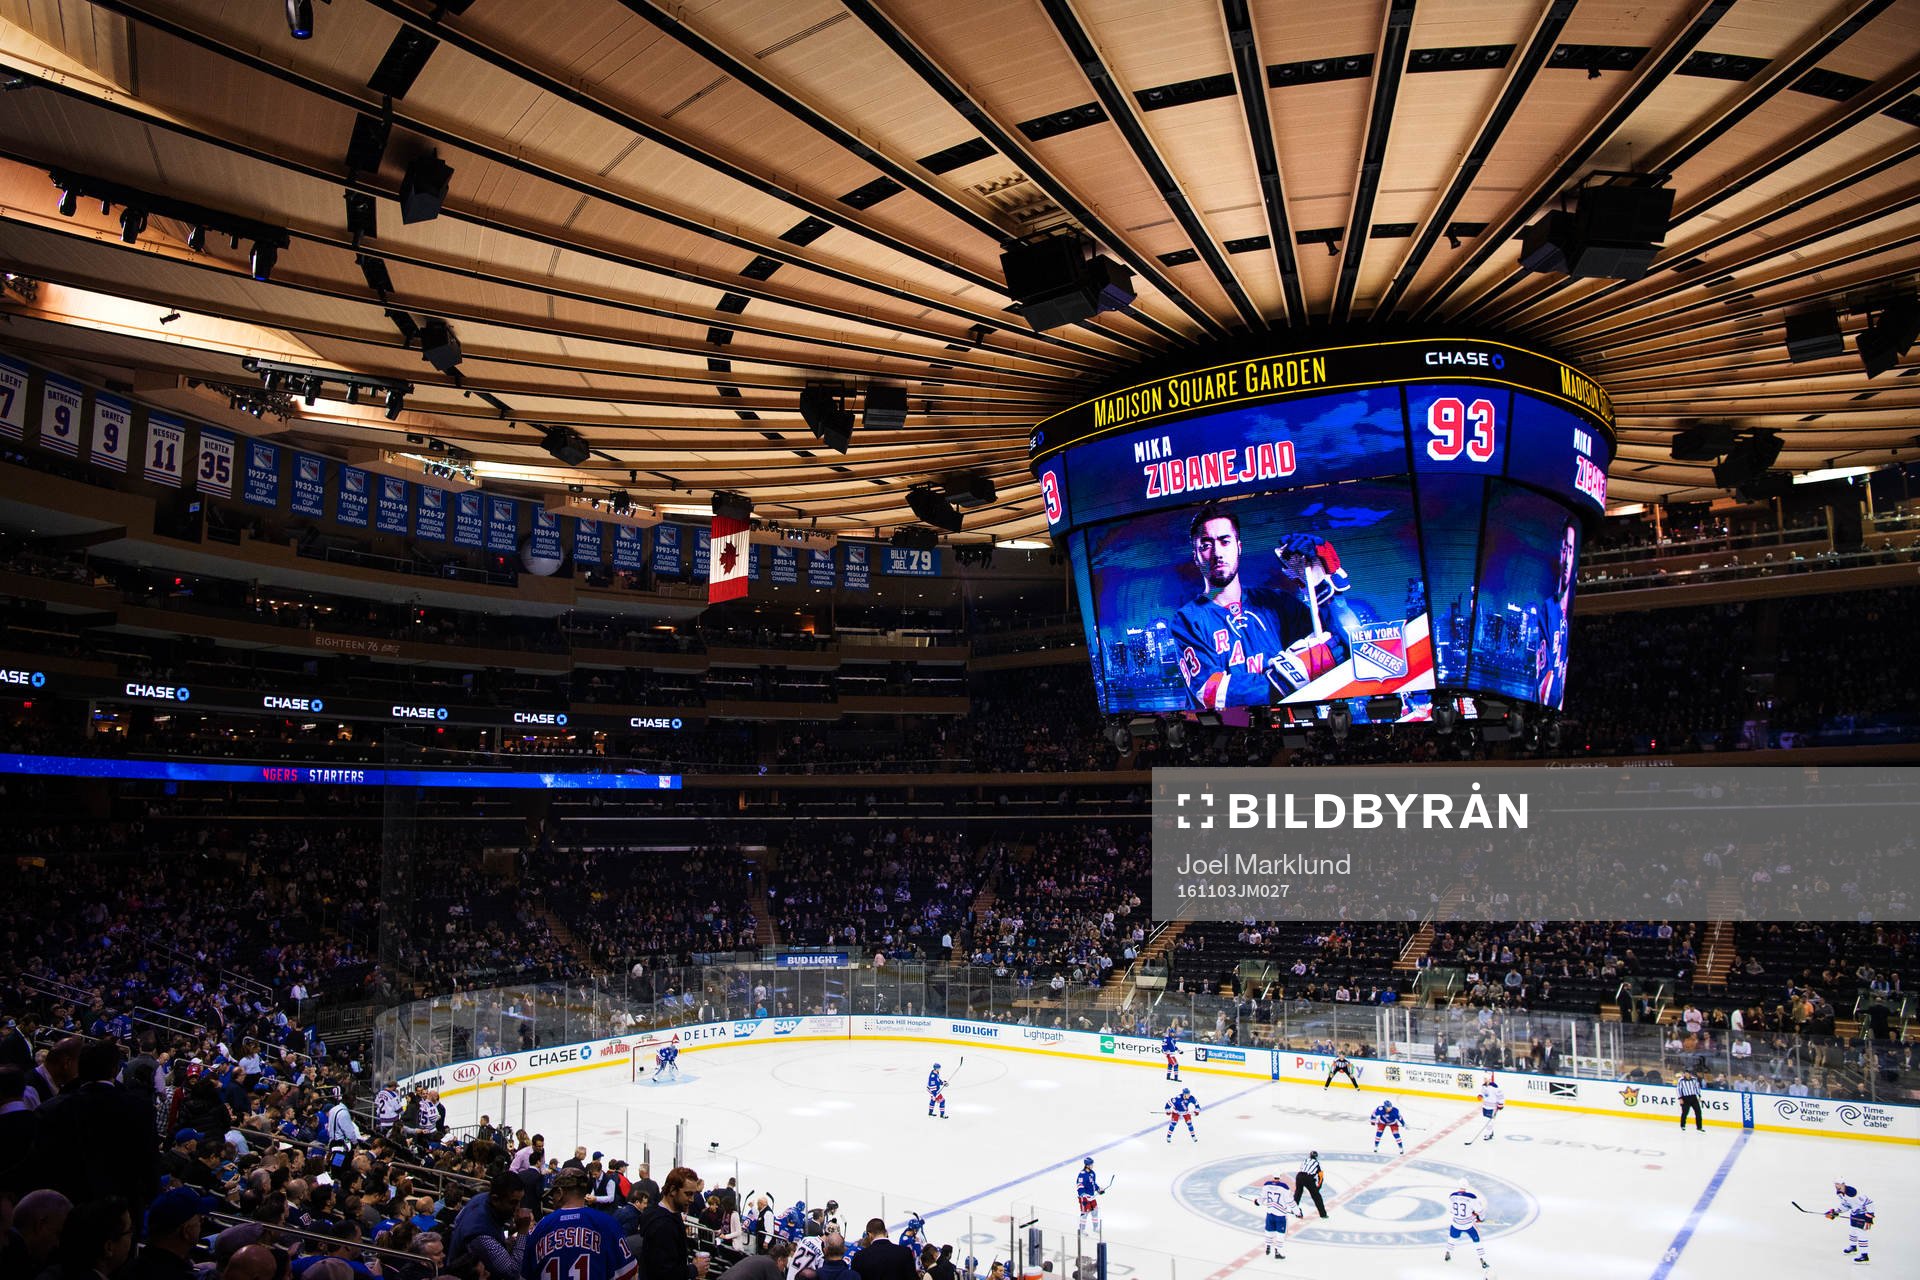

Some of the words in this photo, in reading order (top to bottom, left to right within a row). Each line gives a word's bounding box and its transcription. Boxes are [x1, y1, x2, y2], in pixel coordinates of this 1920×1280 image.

[1425, 351, 1489, 366] CHASE
[1094, 386, 1162, 428] MADISON
[1168, 369, 1238, 408] SQUARE
[1245, 356, 1326, 393] GARDEN
[54, 405, 70, 437] 9
[1427, 397, 1495, 462] 93
[103, 423, 119, 453] 9
[152, 440, 176, 473] 11
[1134, 436, 1172, 463] MIKA
[200, 451, 230, 483] 35
[1143, 440, 1297, 499] ZIBANEJAD
[1040, 470, 1062, 526] 3
[890, 549, 908, 560] BILLY
[910, 550, 931, 570] 79
[892, 560, 908, 570] JOEL
[1351, 629, 1373, 641] NEW
[1375, 626, 1401, 639] YORK
[315, 637, 365, 649] EIGHTEEN
[1359, 642, 1403, 673] RANGERS
[126, 683, 175, 700] CHASE
[263, 696, 310, 711] CHASE
[392, 706, 435, 719] CHASE
[514, 712, 555, 725] CHASE
[630, 717, 670, 729] CHASE
[309, 769, 364, 783] STARTERS
[787, 956, 808, 964] BUD
[809, 955, 838, 964] LIGHT
[734, 1022, 756, 1035] SAP
[774, 1019, 797, 1032] SAP
[952, 1024, 971, 1034] BUD
[972, 1026, 998, 1037] LIGHT
[684, 1027, 727, 1041] DELTA
[1023, 1028, 1064, 1043] Lightpath
[1102, 1038, 1164, 1054] enterpris
[530, 1048, 578, 1067] CHASE
[457, 1068, 475, 1081] KIA
[493, 1062, 512, 1073] KIA
[1385, 1067, 1401, 1075] CORE
[1457, 1073, 1472, 1082] CORE
[1641, 1094, 1729, 1111] DRAFNGS
[1800, 1101, 1820, 1109] Time
[1800, 1108, 1830, 1117] Warner
[1863, 1106, 1884, 1114] Time
[1800, 1115, 1824, 1123] Cable
[1863, 1113, 1894, 1122] Warner
[1863, 1120, 1888, 1129] Cable
[536, 1226, 601, 1264] MESSIER
[540, 1253, 591, 1280] 11
